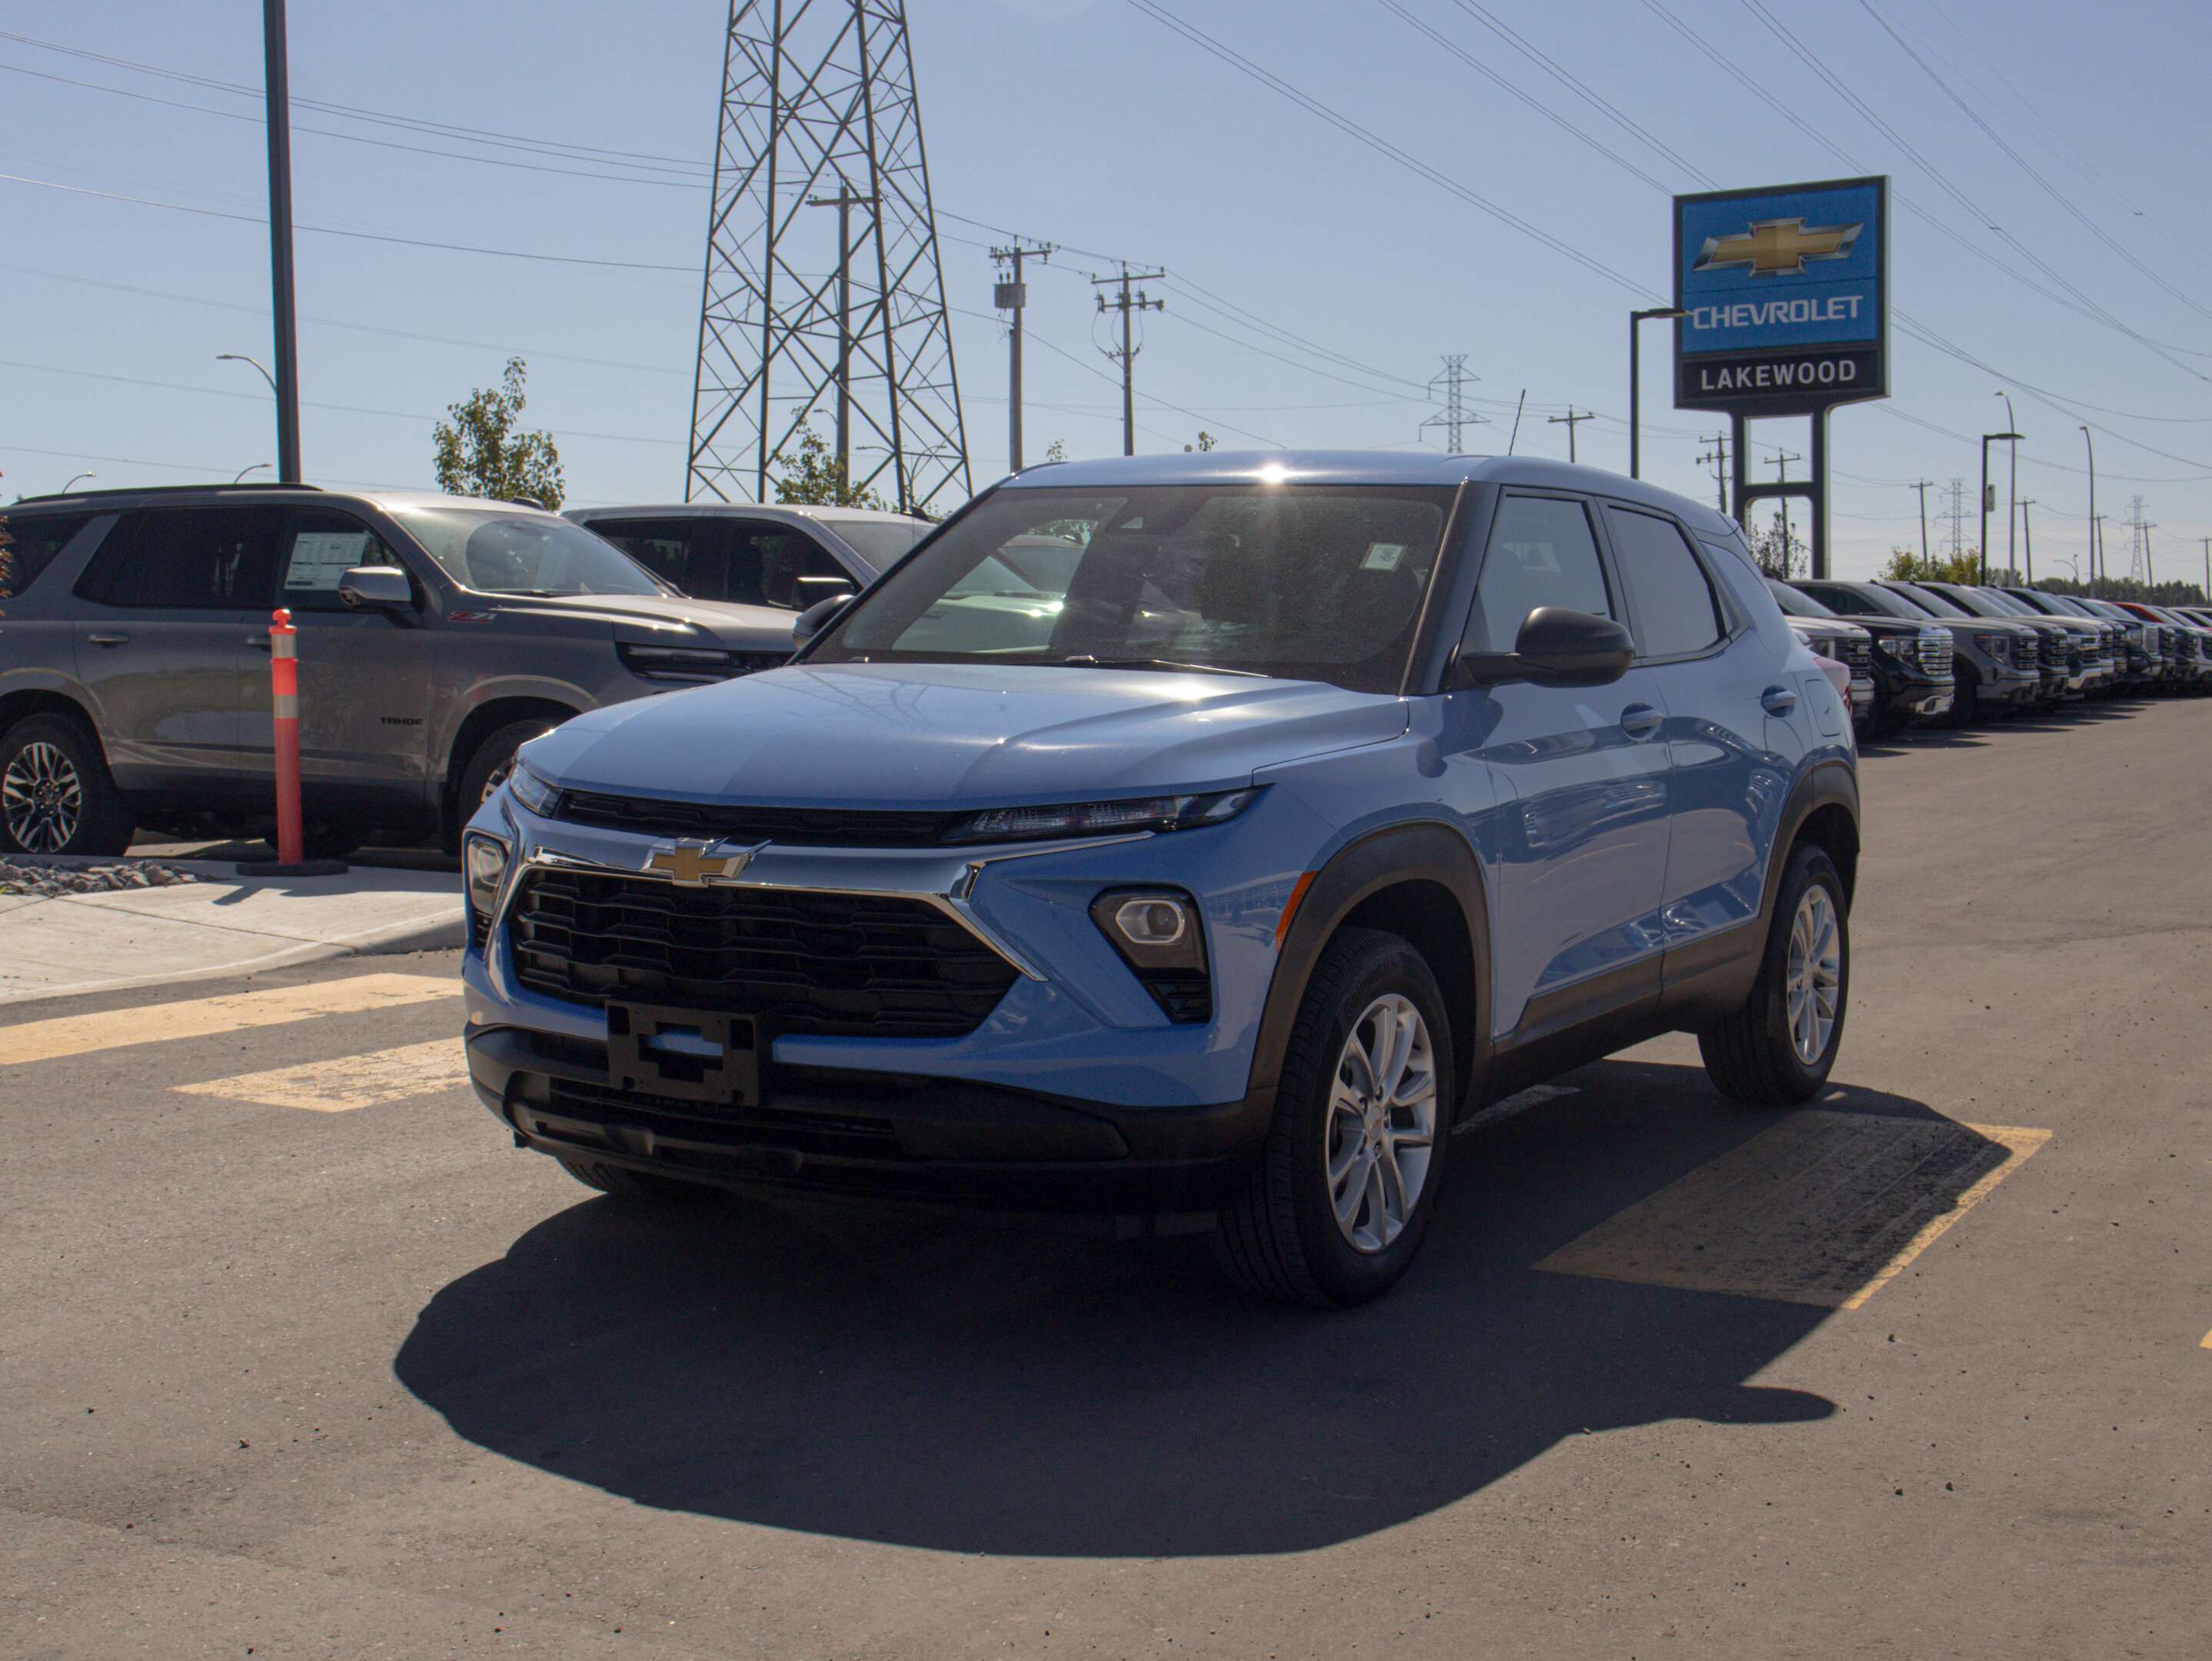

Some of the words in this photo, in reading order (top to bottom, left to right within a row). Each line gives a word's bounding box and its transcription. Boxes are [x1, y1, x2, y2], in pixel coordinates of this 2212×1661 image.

[1693, 295, 1863, 329] CHEVROLET
[1701, 360, 1856, 390] LAKEWOOD
[449, 611, 496, 622] Z71
[379, 717, 424, 725] TAHOE
